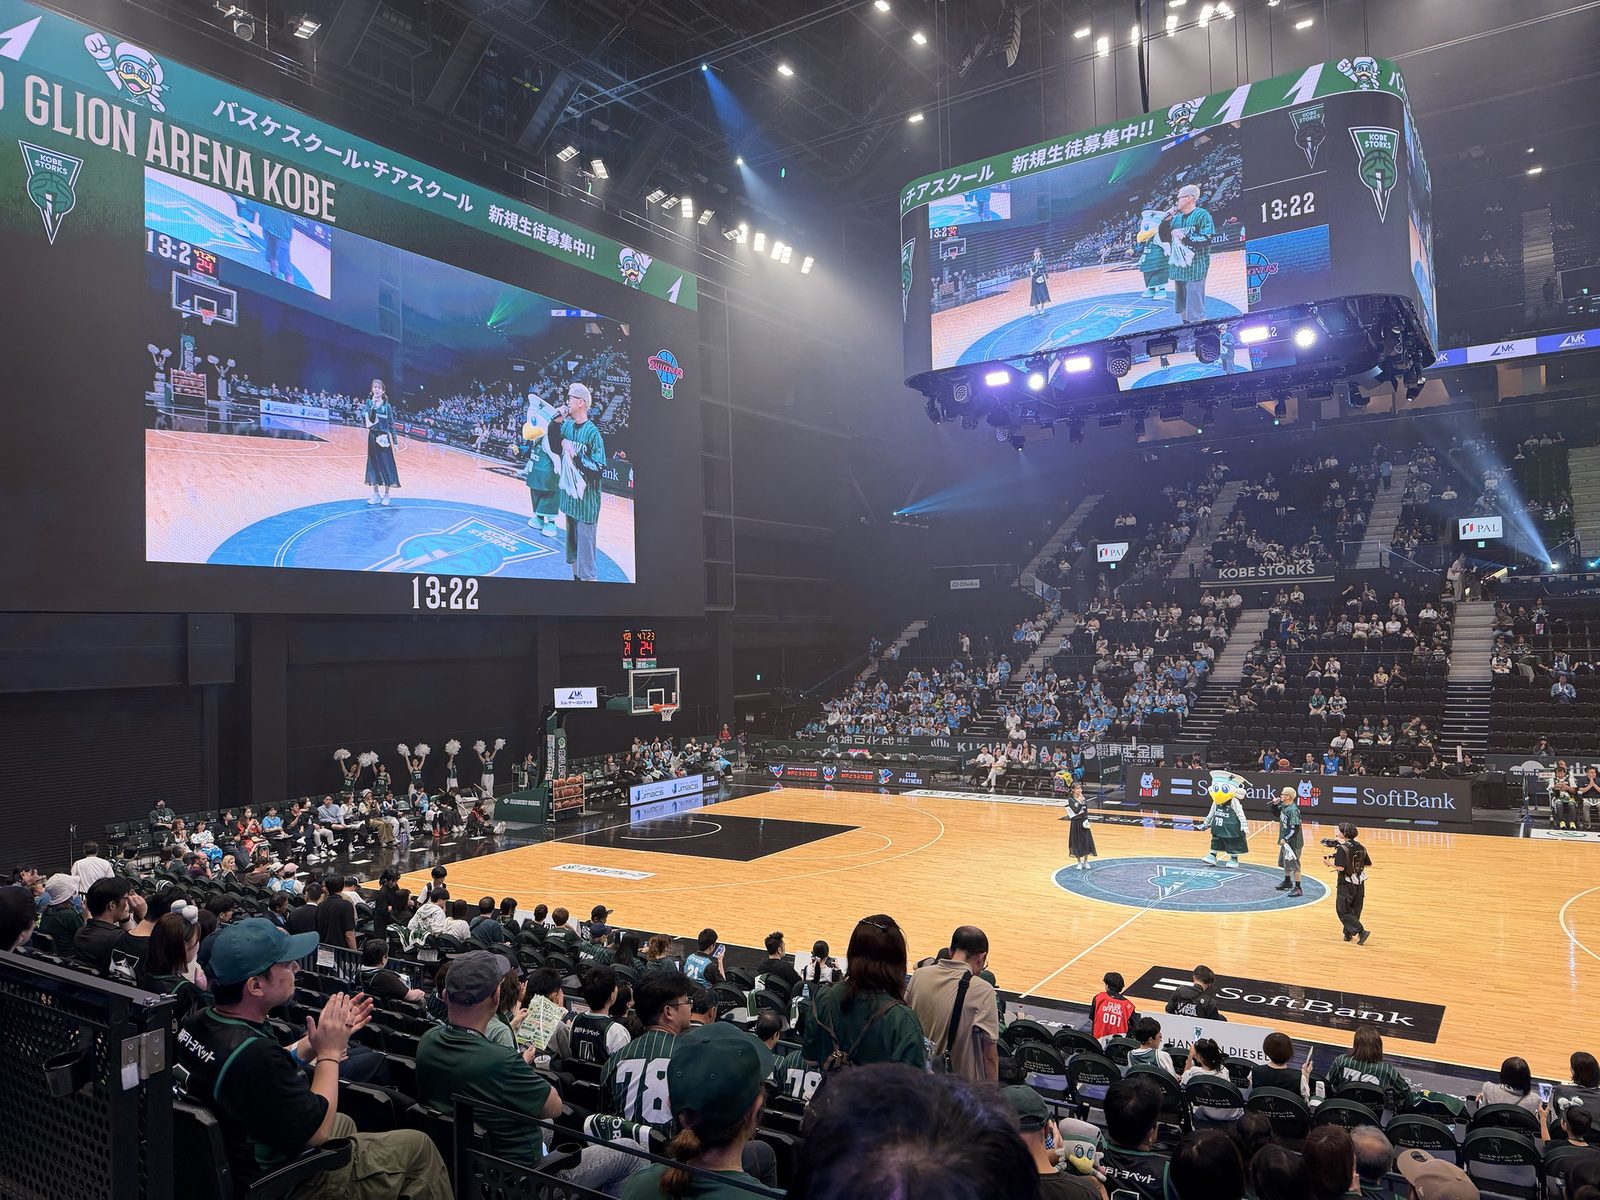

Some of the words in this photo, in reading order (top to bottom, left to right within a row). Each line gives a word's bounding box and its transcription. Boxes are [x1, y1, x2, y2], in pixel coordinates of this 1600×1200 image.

[1011, 119, 1154, 175] 新規生徒募集中!!
[1364, 140, 1392, 149] STORKS
[1368, 133, 1388, 142] KOBE
[24, 75, 136, 157] GLION
[145, 118, 257, 197] ARENA
[262, 159, 337, 222] KOBE
[213, 99, 474, 212] バスケスクール・チアスクール
[34, 159, 69, 175] STORKS
[39, 154, 64, 167] KOBE
[1261, 192, 1315, 223] 13:22
[487, 203, 597, 261] 新規生徒募集中!!
[929, 226, 947, 240] 13:2
[146, 230, 191, 266] 13:2
[1476, 522, 1500, 533] PAL
[1218, 566, 1256, 579] KOBE
[1257, 562, 1316, 577] STORKS
[412, 576, 479, 610] 13:22
[640, 641, 653, 656] 24
[1362, 787, 1457, 810] SoftBank
[1215, 986, 1416, 1029] SoftBank
[1103, 1013, 1122, 1027] 001
[1168, 1037, 1226, 1056] HANN
[616, 1058, 673, 1124] 78
[786, 1068, 823, 1101] 78
[1106, 1166, 1157, 1185] 戸トヨペット
